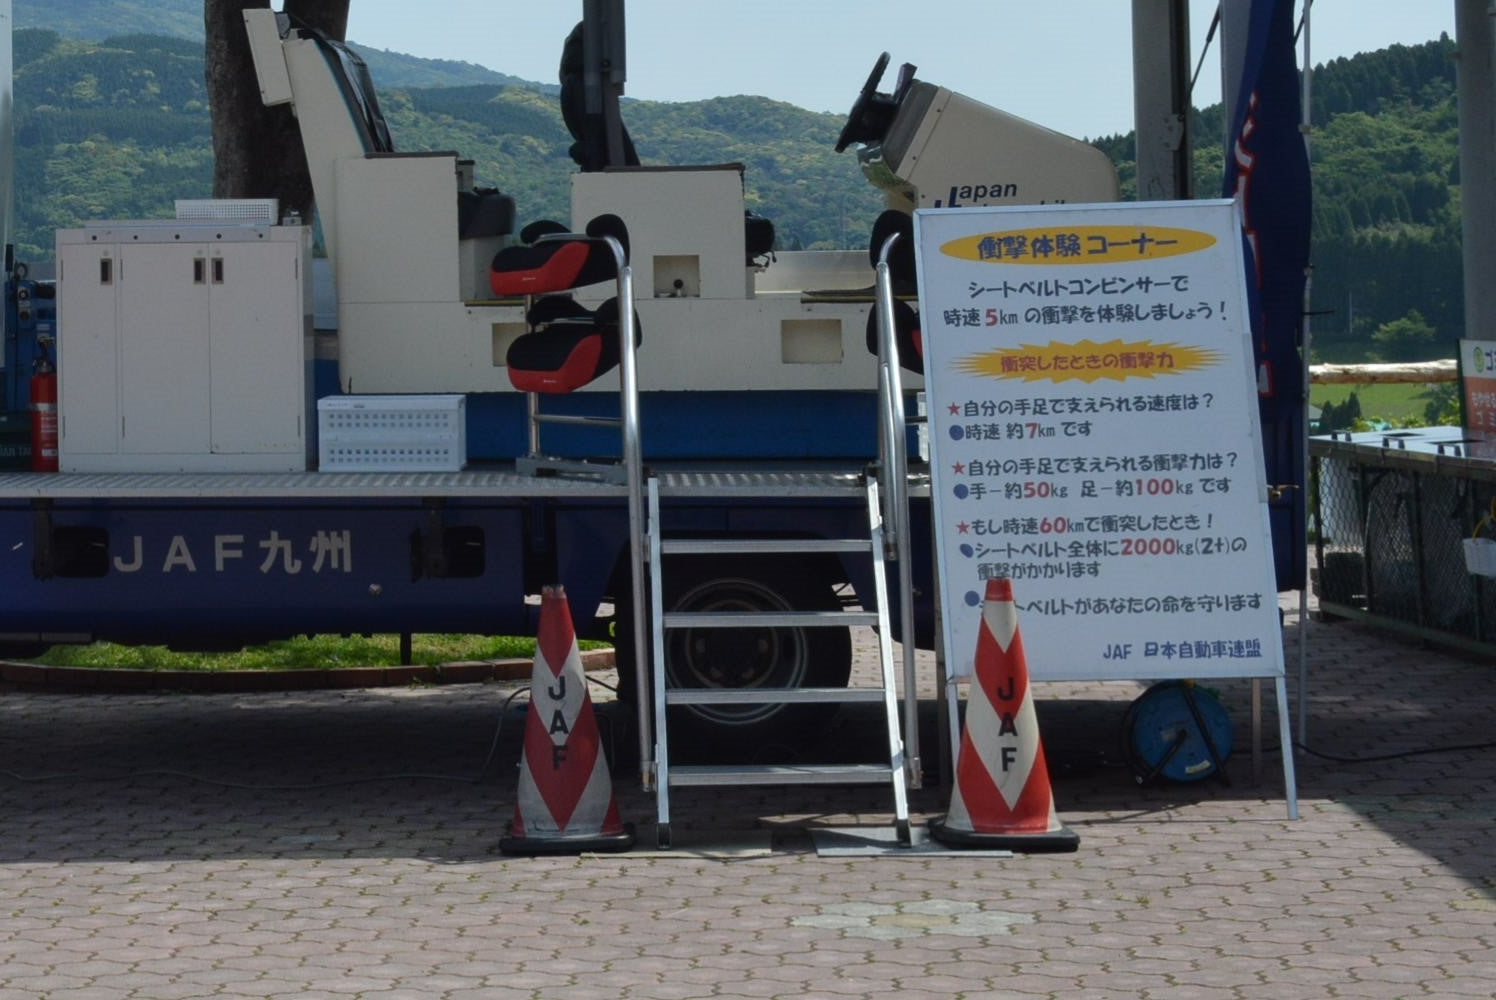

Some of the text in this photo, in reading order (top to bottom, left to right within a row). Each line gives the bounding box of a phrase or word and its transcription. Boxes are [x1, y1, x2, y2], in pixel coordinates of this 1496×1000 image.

[977, 231, 1179, 262] 衝撃体験コーナー
[968, 275, 1190, 299] シートベルトコンビンサーで
[1000, 351, 1176, 373] 衝突したときの衝撃力
[963, 393, 1214, 417] 自分の手足で支えられる速度は？
[968, 452, 1239, 477] 自分の手足で支えられる衝撃力は？
[977, 561, 1102, 581] 衝撃がかかります
[1103, 639, 1263, 660] JAF 日本自動車連盟
[547, 675, 569, 770] JAF
[997, 677, 1018, 772] JAF
